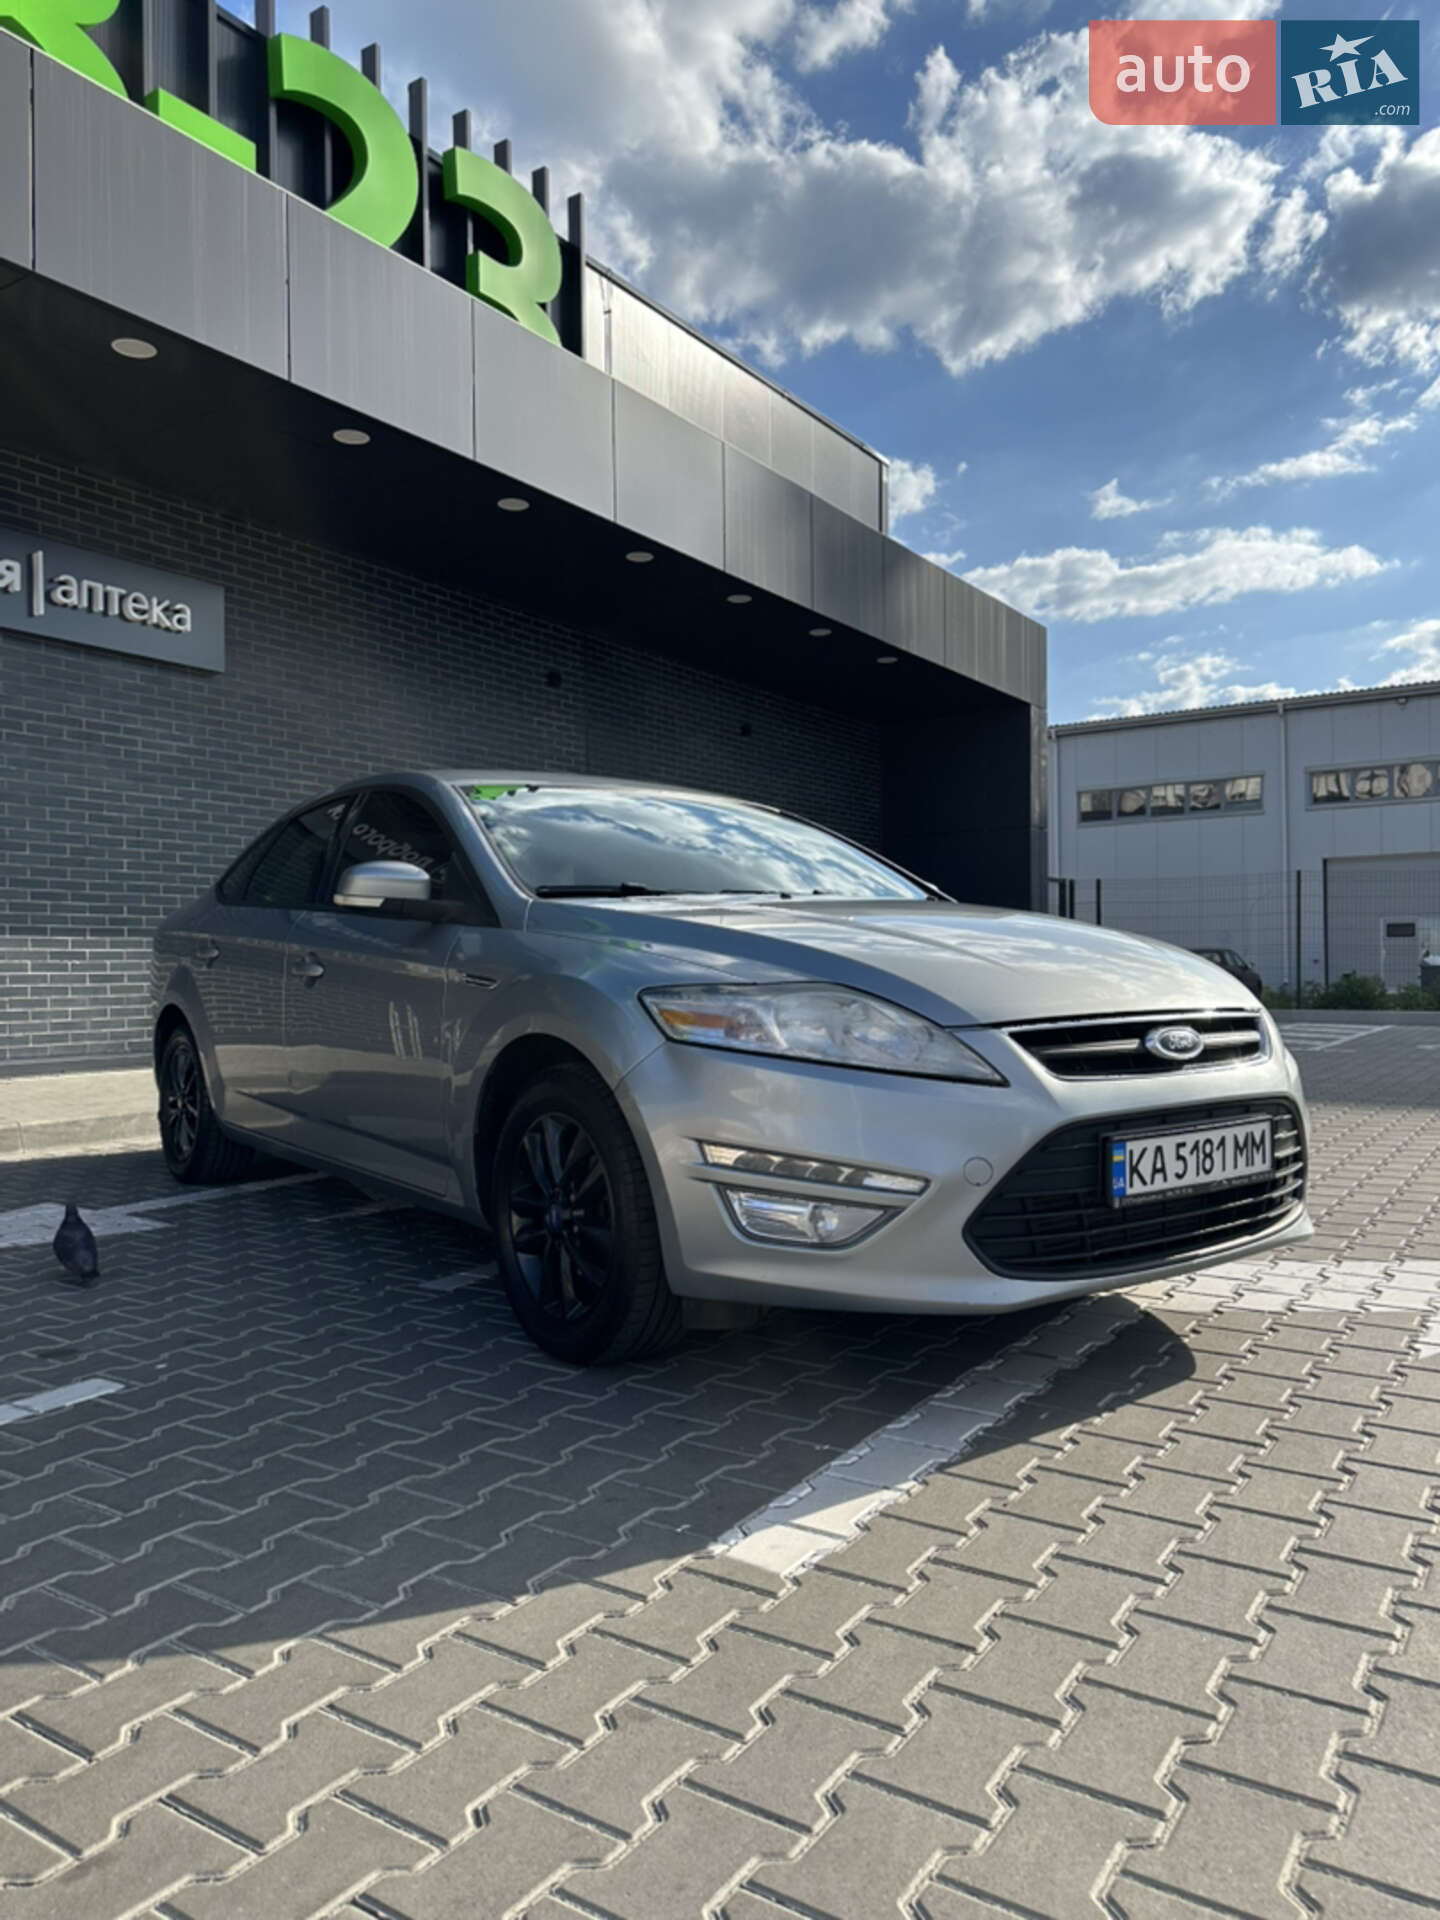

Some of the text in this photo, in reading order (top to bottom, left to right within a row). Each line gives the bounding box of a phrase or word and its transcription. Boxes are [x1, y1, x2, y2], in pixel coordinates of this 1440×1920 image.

[51, 574, 192, 633] аптека
[1129, 1129, 1267, 1188] KA 5181 MM
